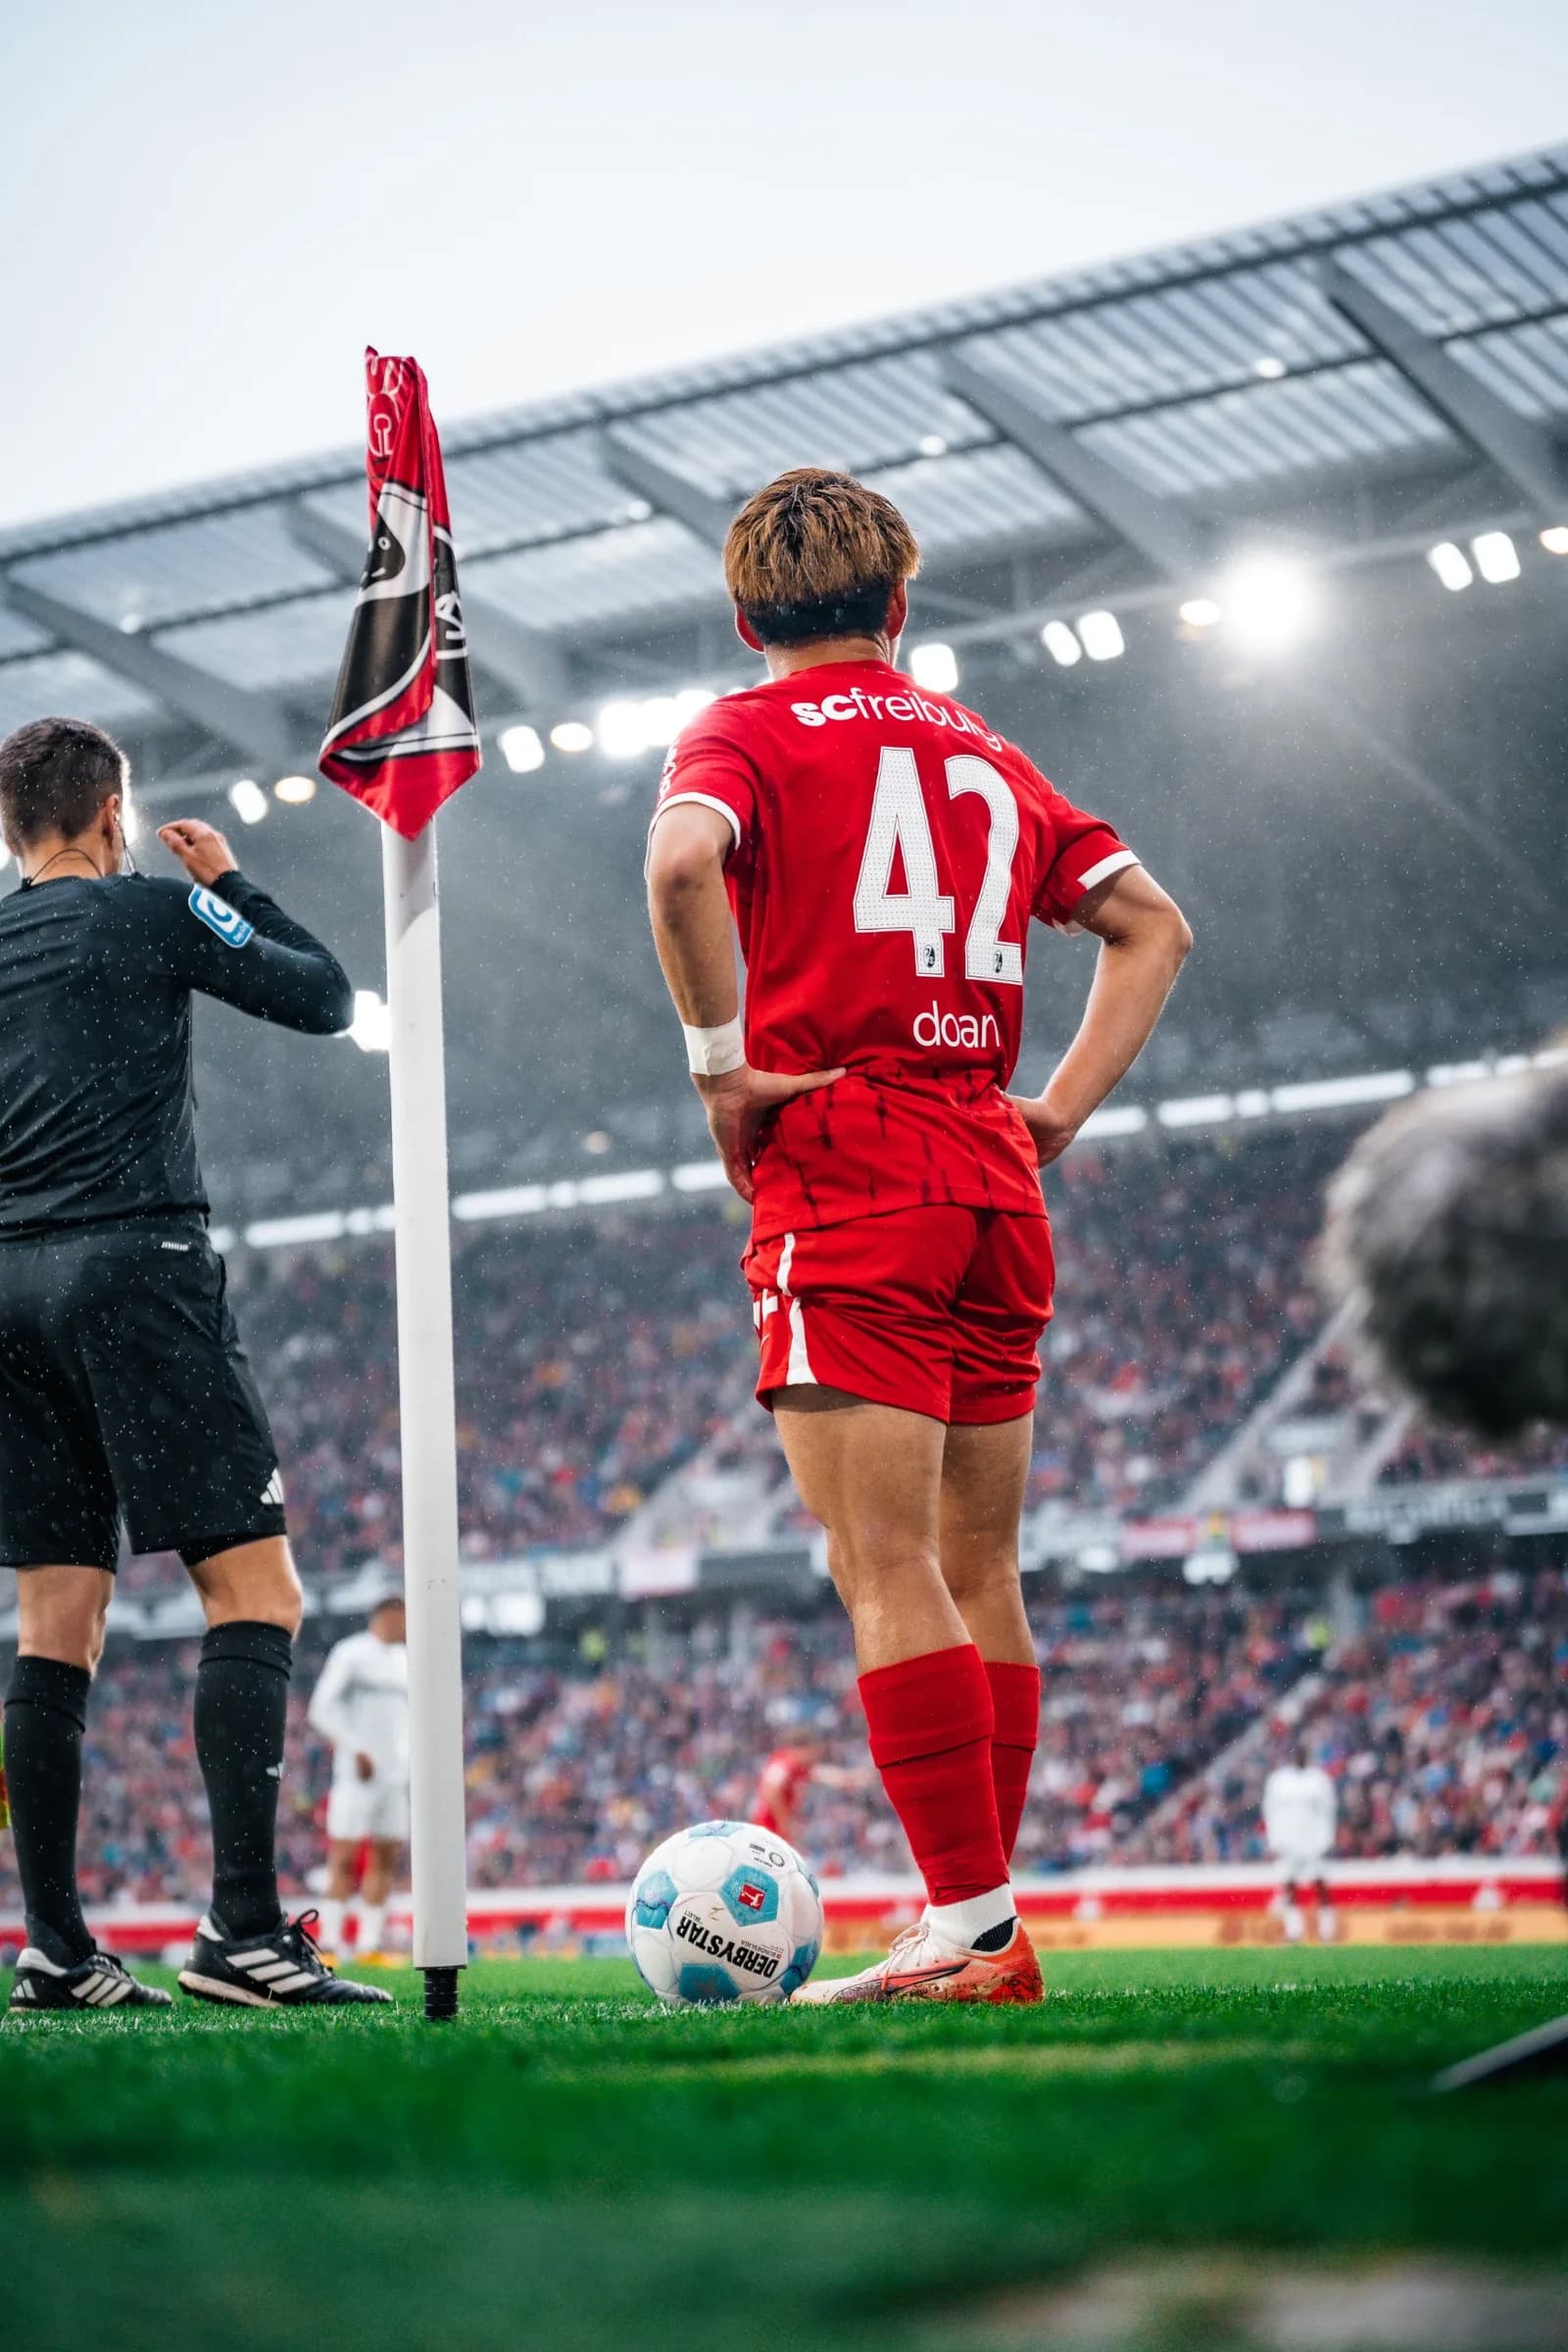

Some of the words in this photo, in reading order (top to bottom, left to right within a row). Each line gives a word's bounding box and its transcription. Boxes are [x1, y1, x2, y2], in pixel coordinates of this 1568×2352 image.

[853, 746, 1023, 985] 42
[912, 1000, 1000, 1048] doan
[676, 1916, 779, 1978] DERBYSTAR
